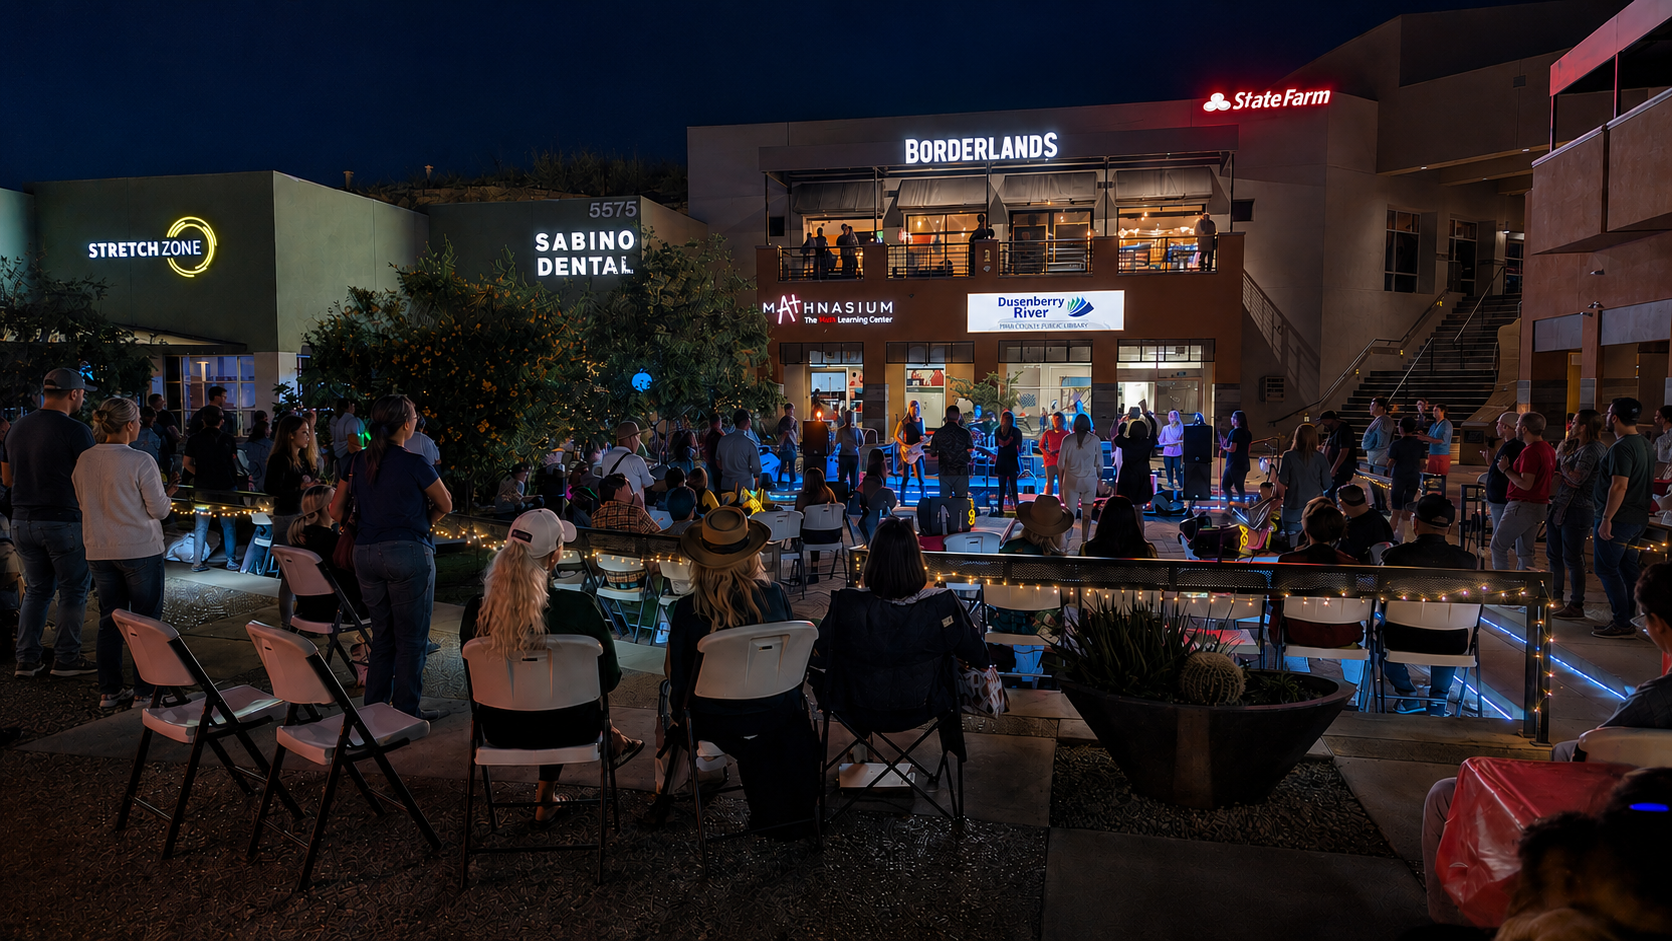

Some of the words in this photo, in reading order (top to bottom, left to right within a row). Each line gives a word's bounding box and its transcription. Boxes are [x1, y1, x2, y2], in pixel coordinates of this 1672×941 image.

[905, 132, 1058, 164] BORDERLANDS
[589, 201, 637, 218] 5575
[88, 241, 159, 259] STRETCH
[161, 240, 202, 256] ZONE
[535, 230, 635, 252] SABINO
[537, 256, 634, 276] DENTAL
[998, 296, 1065, 308] Dusenberry
[804, 316, 818, 324] The
[837, 315, 868, 326] Learning
[869, 315, 893, 324] Center
[1014, 307, 1049, 318] River
